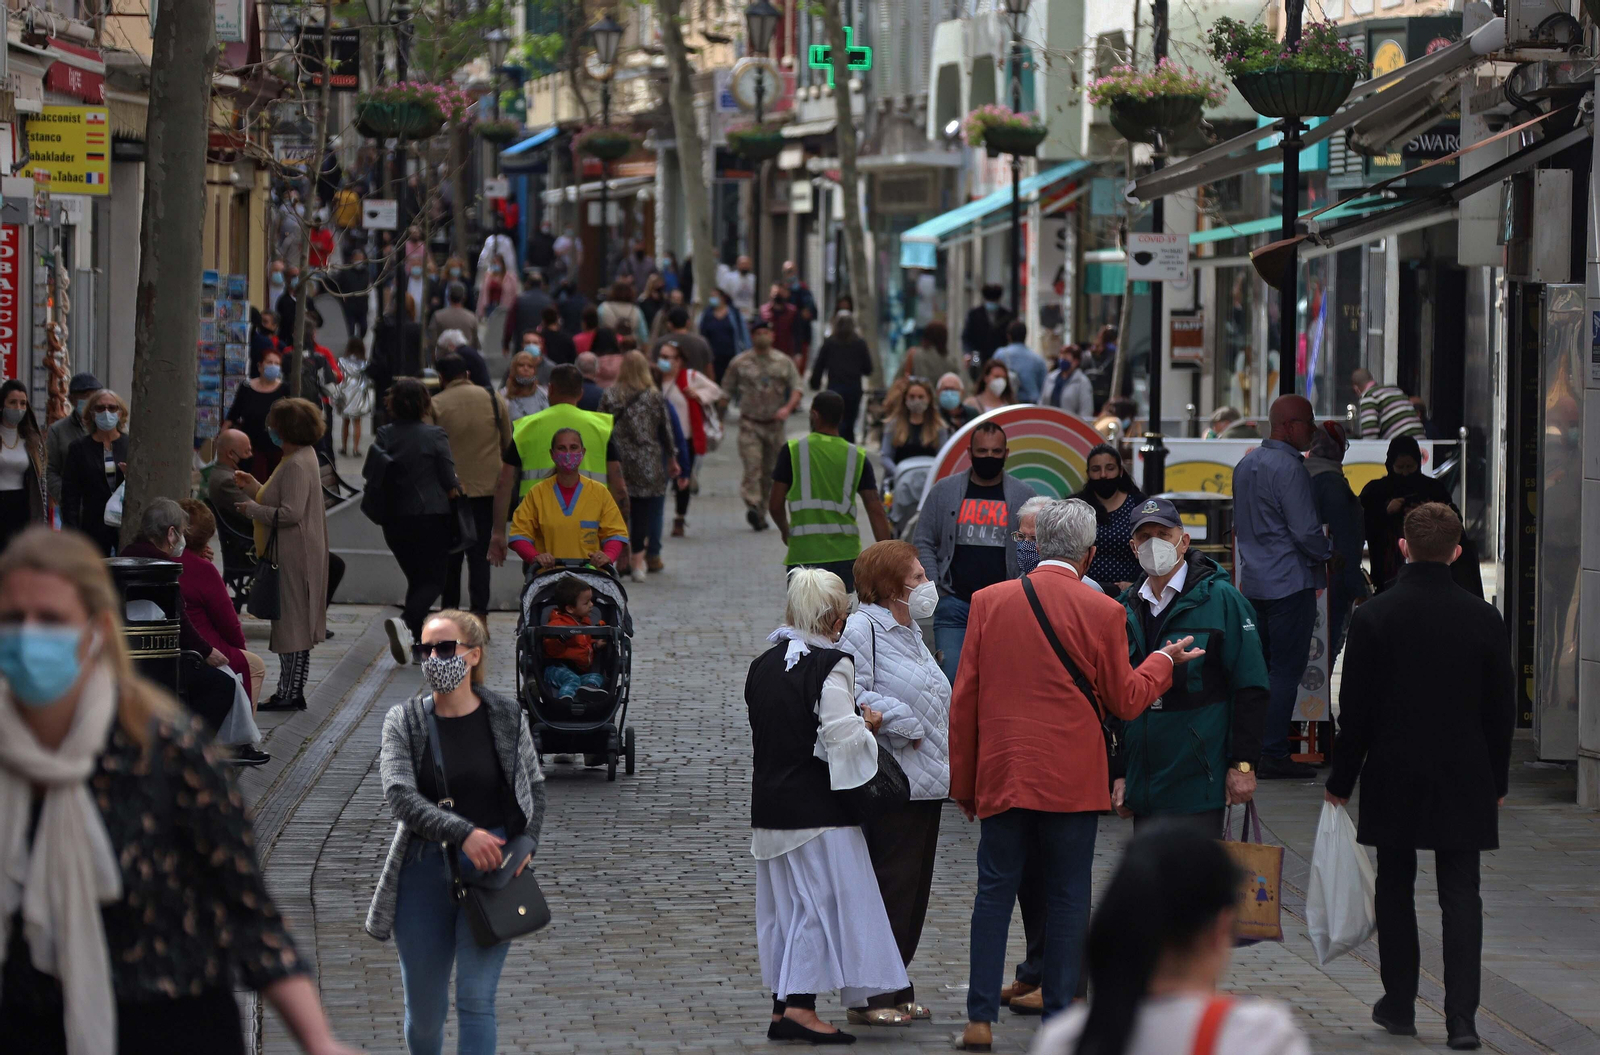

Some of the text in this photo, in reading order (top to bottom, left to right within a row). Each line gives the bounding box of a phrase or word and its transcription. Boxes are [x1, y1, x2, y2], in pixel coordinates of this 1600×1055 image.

[27, 112, 80, 124] obacconist
[28, 150, 75, 162] abaklader
[58, 170, 84, 183] Tabac
[141, 635, 178, 649] LITTER
